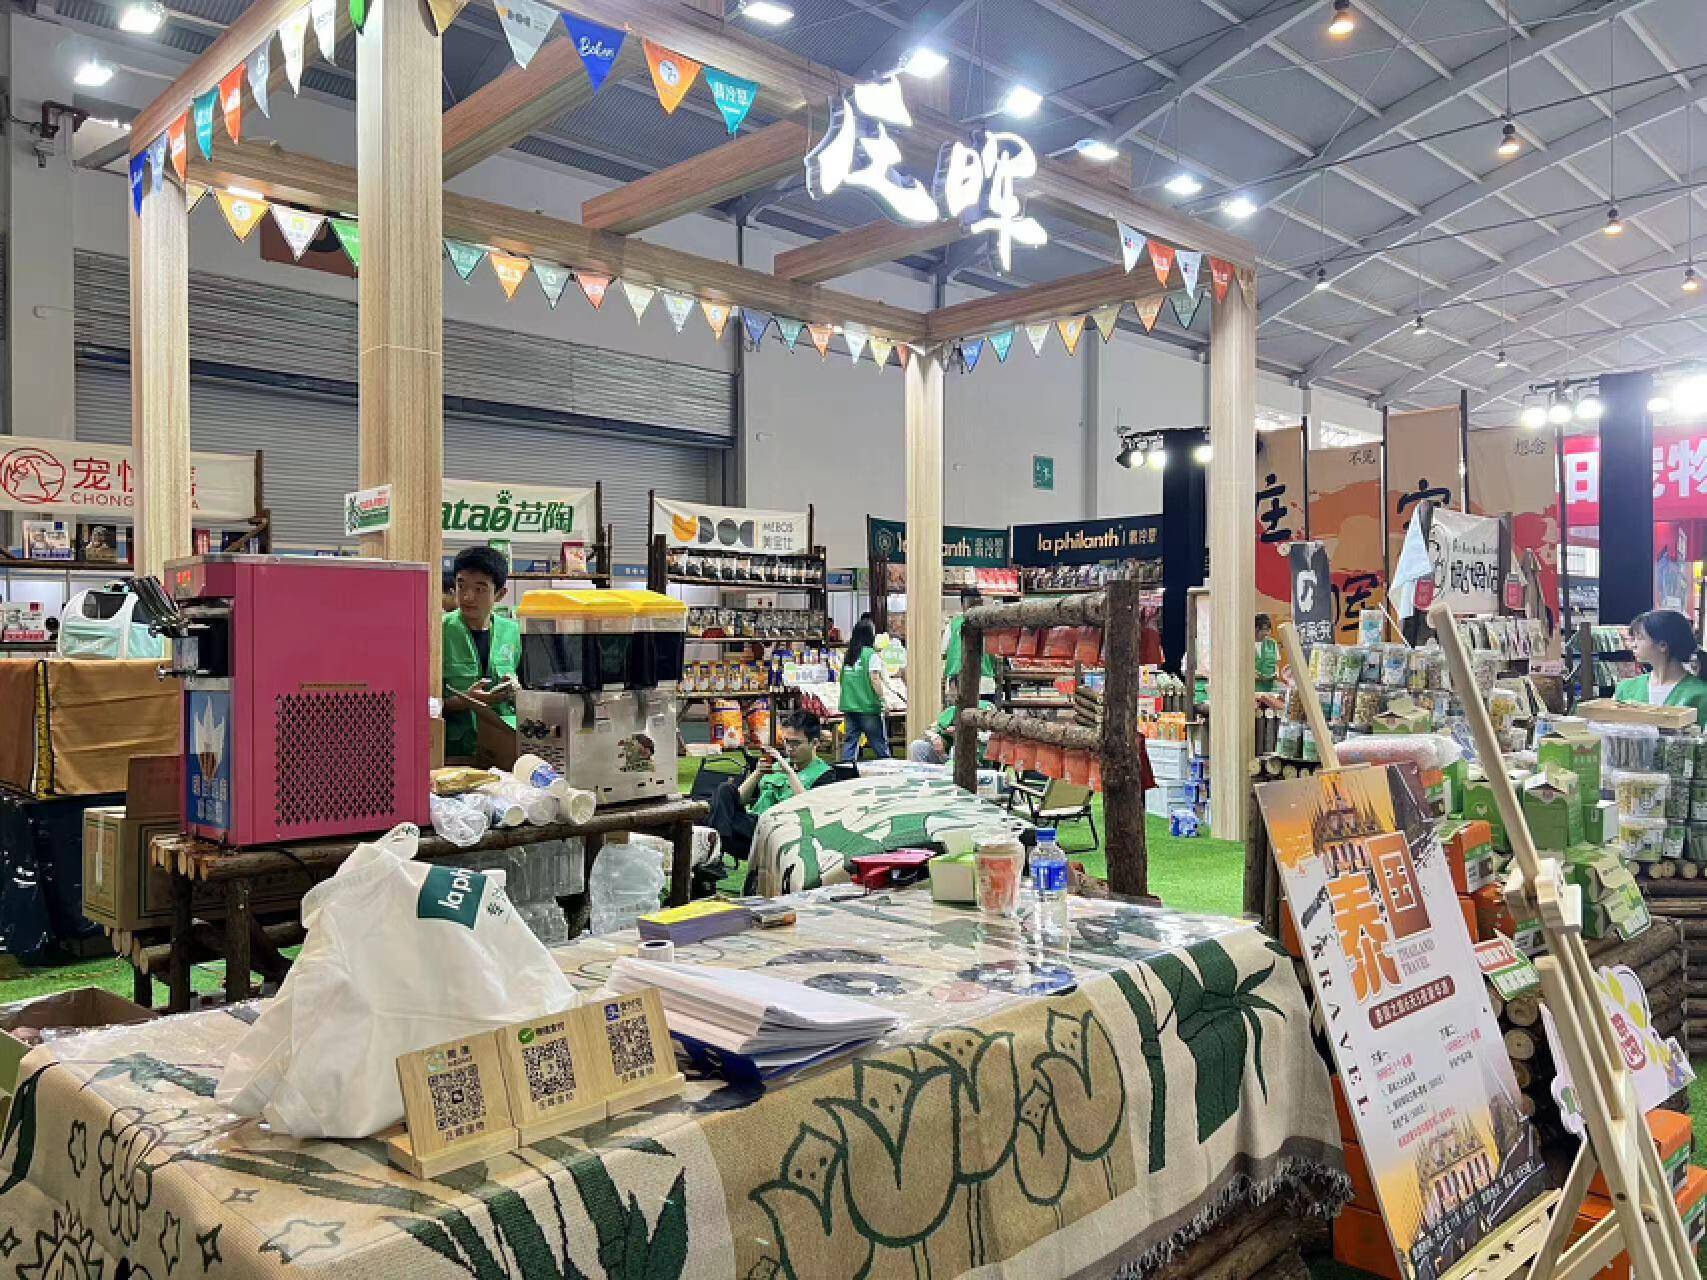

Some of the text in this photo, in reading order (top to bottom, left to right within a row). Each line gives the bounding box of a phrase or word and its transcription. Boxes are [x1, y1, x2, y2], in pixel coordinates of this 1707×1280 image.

[515, 499, 574, 534] 芭陶
[1037, 532, 1052, 552] la
[1053, 527, 1120, 557] philanth
